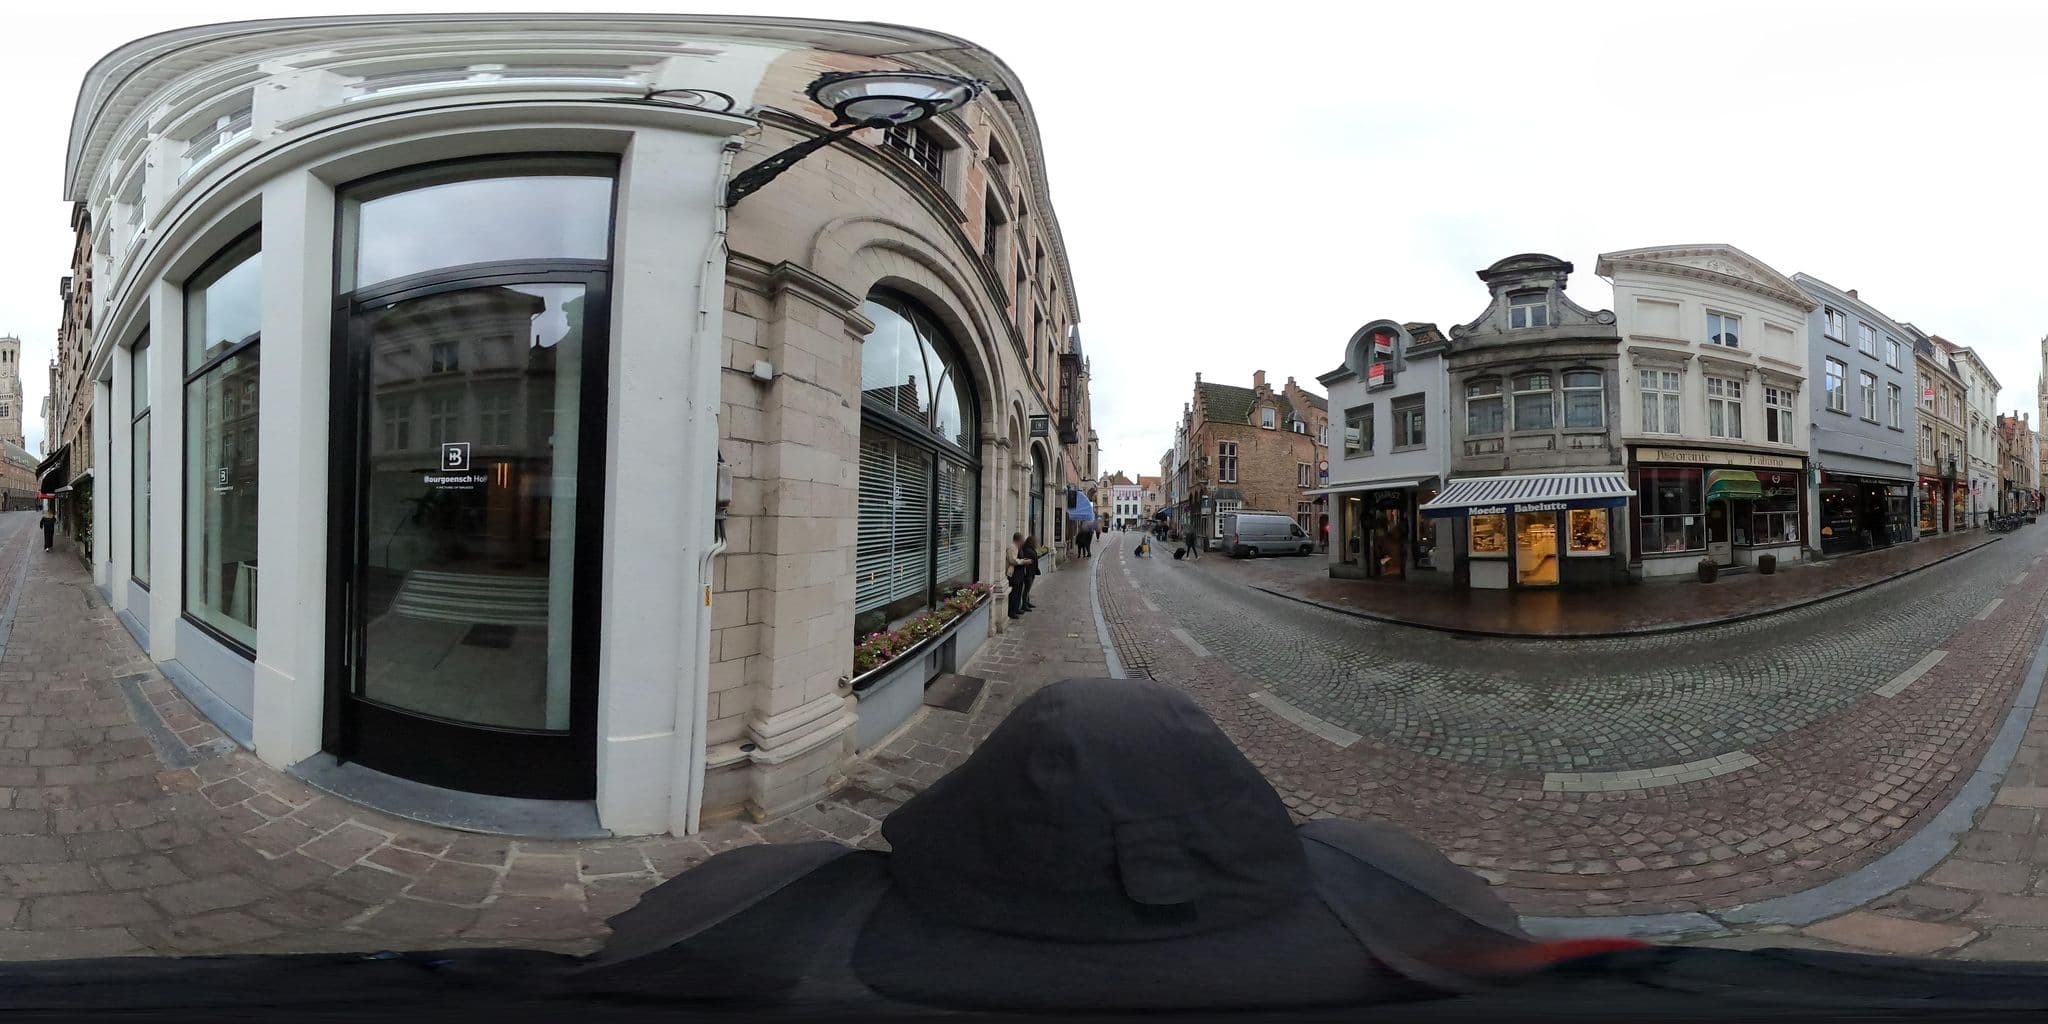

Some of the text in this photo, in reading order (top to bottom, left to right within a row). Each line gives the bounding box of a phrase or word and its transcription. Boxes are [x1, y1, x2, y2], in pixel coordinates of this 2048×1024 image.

[424, 475, 472, 485] Bourgoensch
[1468, 503, 1568, 516] Moeder Babelutte
